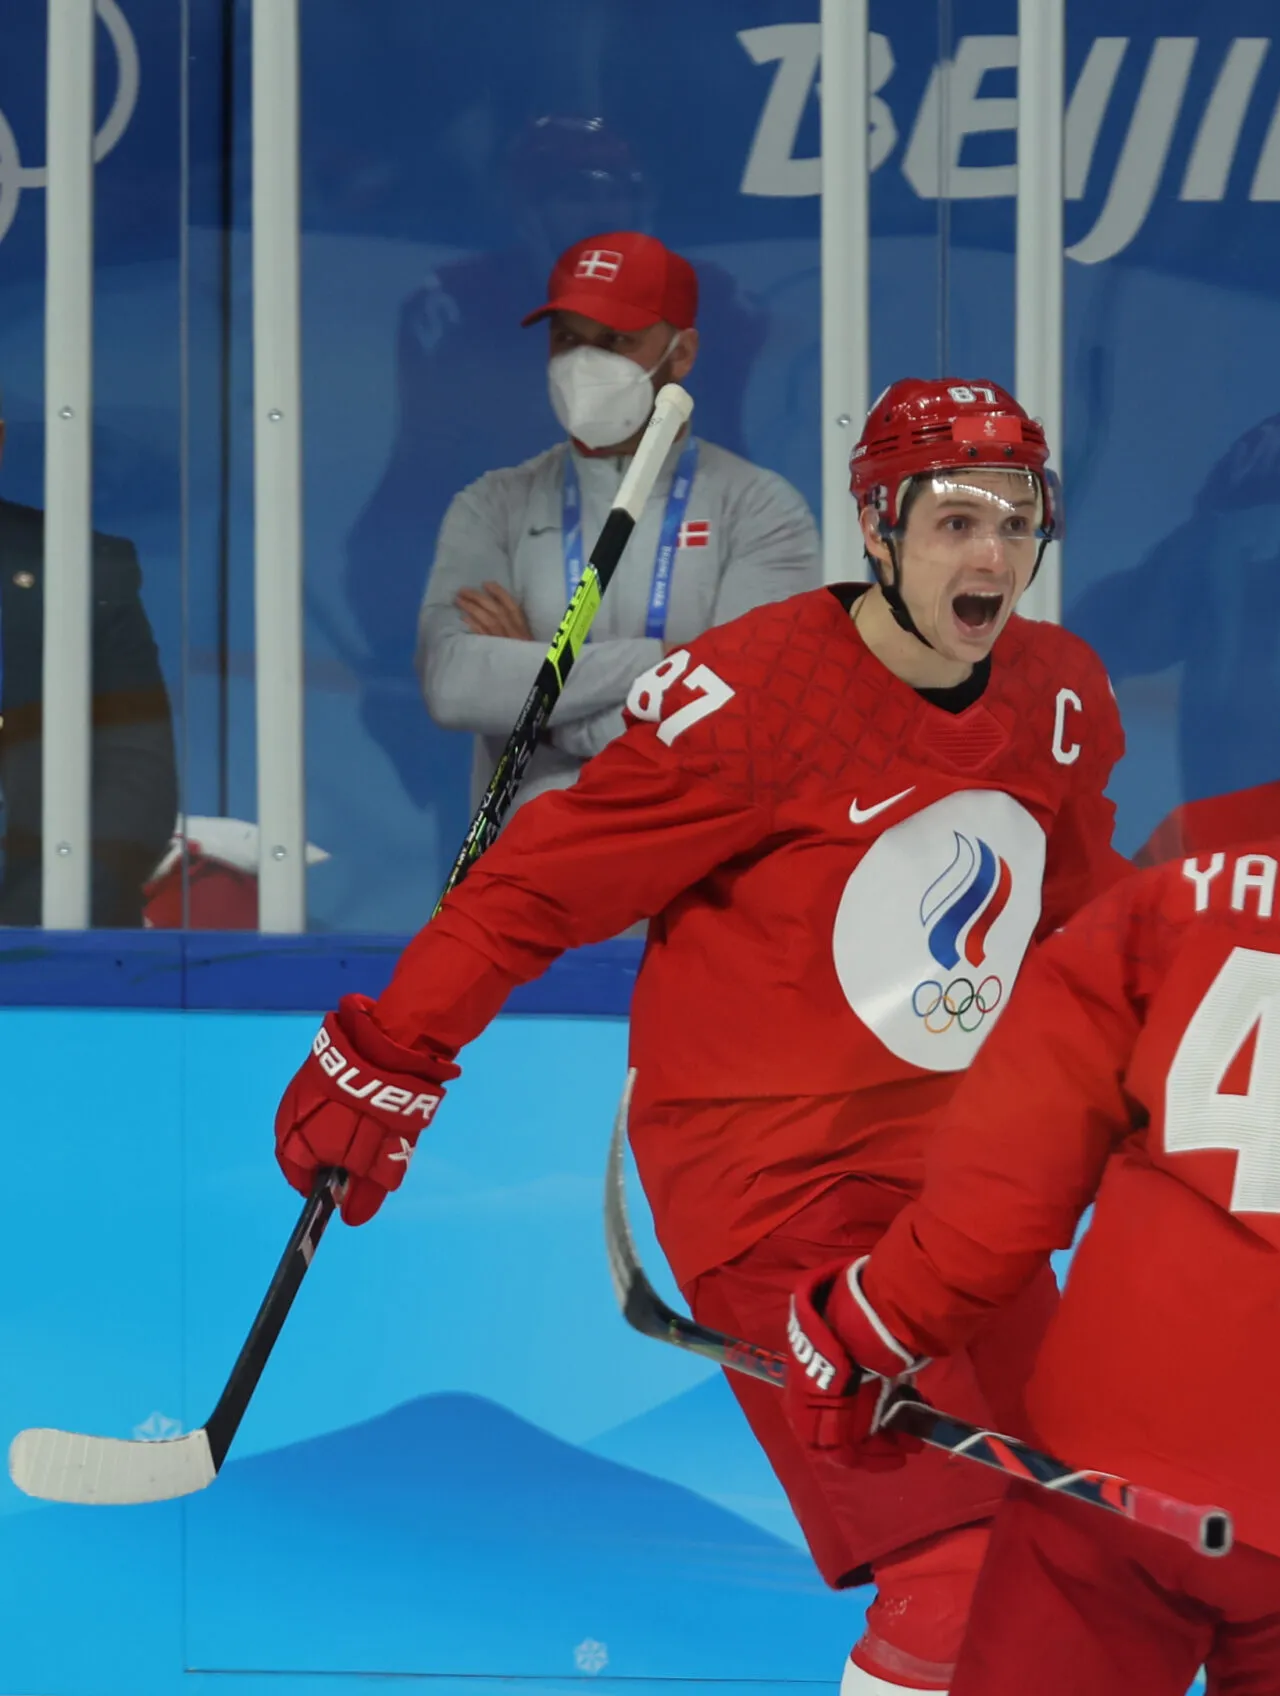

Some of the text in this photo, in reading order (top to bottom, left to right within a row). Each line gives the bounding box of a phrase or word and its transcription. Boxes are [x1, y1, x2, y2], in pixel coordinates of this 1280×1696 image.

[946, 385, 998, 404] 87
[626, 649, 736, 747] 87
[1052, 687, 1083, 765] C
[311, 1026, 441, 1120] BAUER
